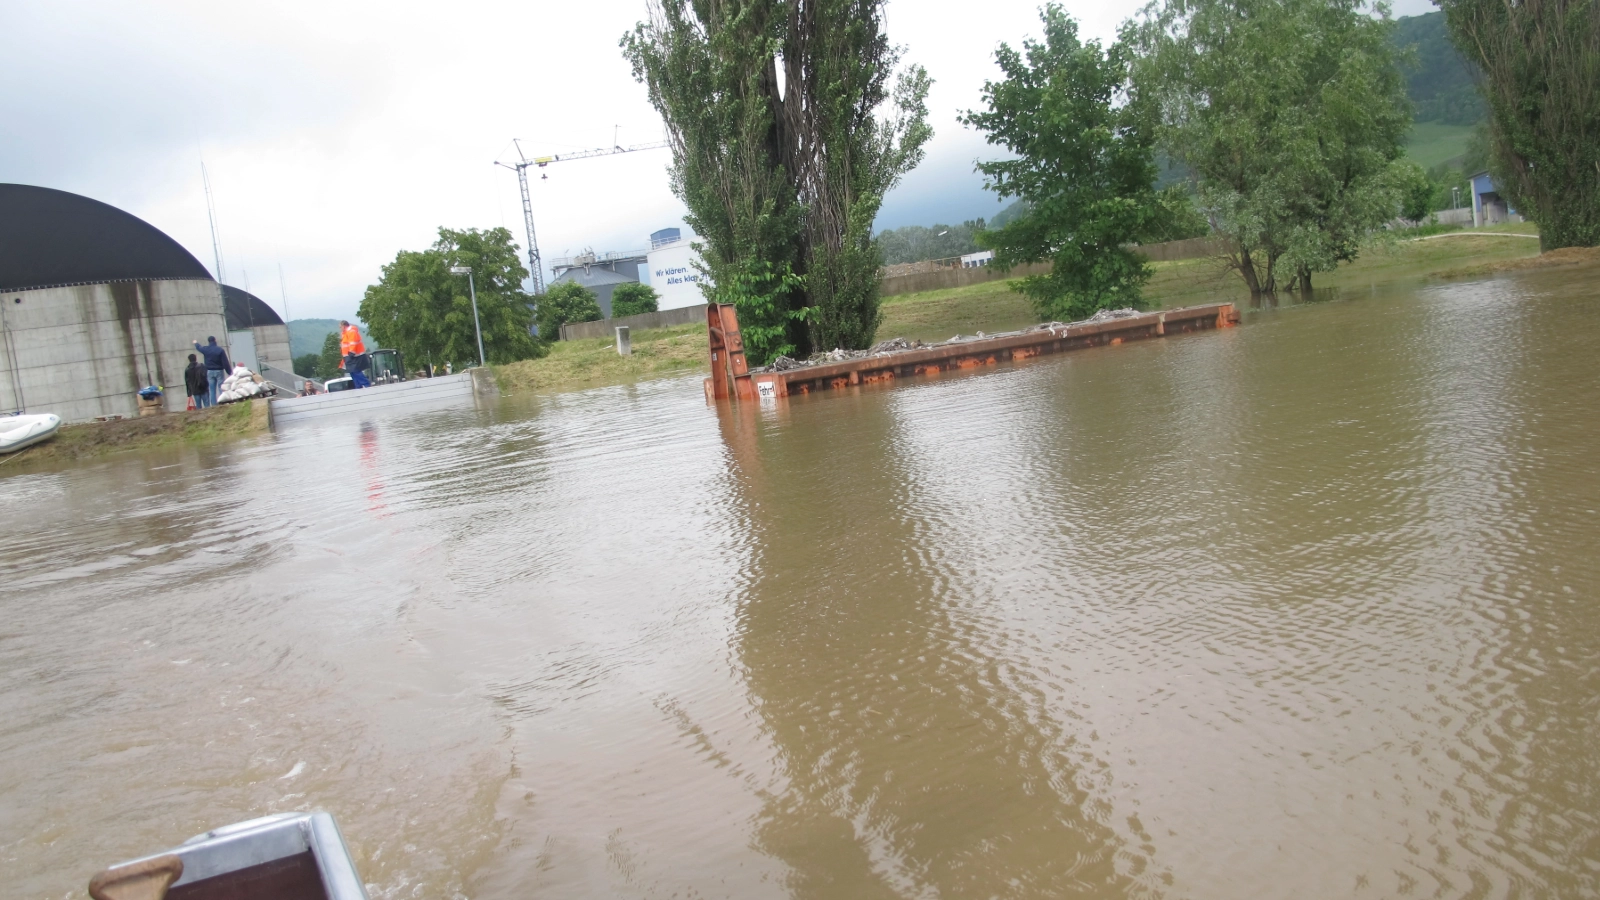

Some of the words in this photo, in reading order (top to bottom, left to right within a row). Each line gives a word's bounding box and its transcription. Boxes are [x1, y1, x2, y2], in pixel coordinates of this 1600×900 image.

[655, 269, 664, 277] Wir
[665, 267, 689, 276] klären.
[667, 277, 683, 285] Alles
